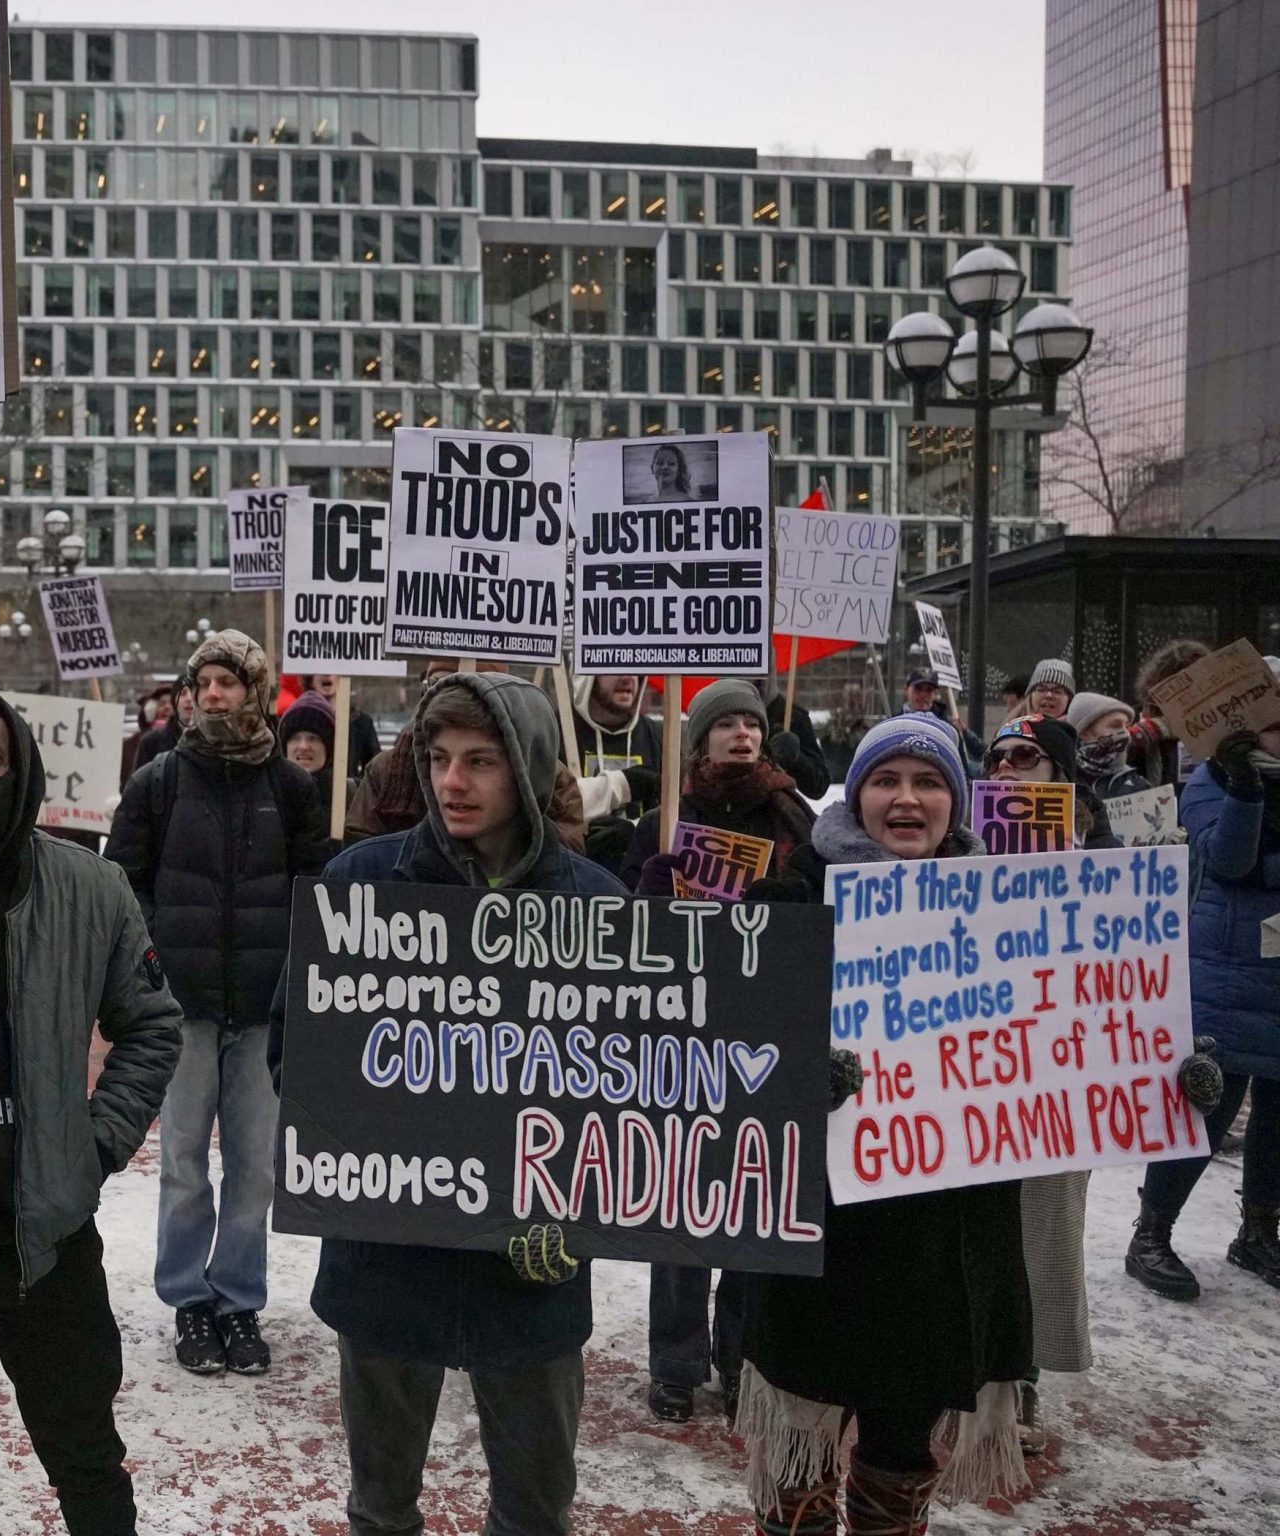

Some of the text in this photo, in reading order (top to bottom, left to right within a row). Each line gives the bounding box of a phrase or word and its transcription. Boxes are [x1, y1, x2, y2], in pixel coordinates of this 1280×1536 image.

[438, 441, 530, 478] NO
[247, 493, 288, 510] NO
[401, 471, 562, 546] TROOPS
[232, 510, 282, 540] TROO
[582, 506, 762, 555] JUSTICE FOR
[801, 516, 839, 547] TOO
[847, 521, 896, 550] COLD
[261, 541, 279, 552] IN
[312, 503, 385, 583] ICE
[234, 552, 282, 574] MINNES
[459, 551, 500, 576] IN
[582, 561, 762, 591] RENEE
[777, 550, 889, 587] ELT ICE
[42, 577, 96, 591] ARREST
[48, 588, 98, 610] JONATHAN
[395, 570, 558, 627] MINNESOTA
[815, 592, 839, 605] OUT
[53, 607, 101, 627] ROSS FOR
[295, 593, 385, 626] OUT OF OU
[582, 595, 762, 636] NICOLE GOOD
[817, 609, 832, 621] OF
[837, 597, 888, 638] MN
[57, 627, 109, 654] MURDER
[287, 629, 384, 661] COMMUNIT
[394, 628, 553, 653] PARTY FOR SOCIALISM & LIBERATION
[584, 648, 758, 663] PARTY FOR SOCIALISM & LIBERATION
[61, 654, 118, 671] NOW!
[15, 705, 94, 749] uck
[983, 796, 1064, 821] ICE
[683, 832, 761, 866] ICE
[982, 821, 1065, 855] OUT!
[679, 848, 756, 896] OUT!
[834, 864, 907, 925] First
[916, 862, 982, 914] they
[1078, 857, 1120, 895] for
[1129, 849, 1178, 896] the
[313, 883, 770, 977] When CRUELTY
[833, 916, 979, 991] mmigrants
[996, 905, 1049, 961] and
[1061, 901, 1083, 954] I
[306, 964, 707, 1027] becomes normal
[883, 980, 1014, 1041] Because
[1033, 968, 1057, 1013] I
[1074, 953, 1168, 1005] KNOW
[361, 1017, 726, 1113] COMPASSION
[939, 1018, 1038, 1090] REST
[1052, 1019, 1086, 1069] of
[1103, 1009, 1174, 1065] the
[854, 1075, 1197, 1183] GOD DAMN POEM
[285, 1106, 823, 1241] becomes RADICAL
